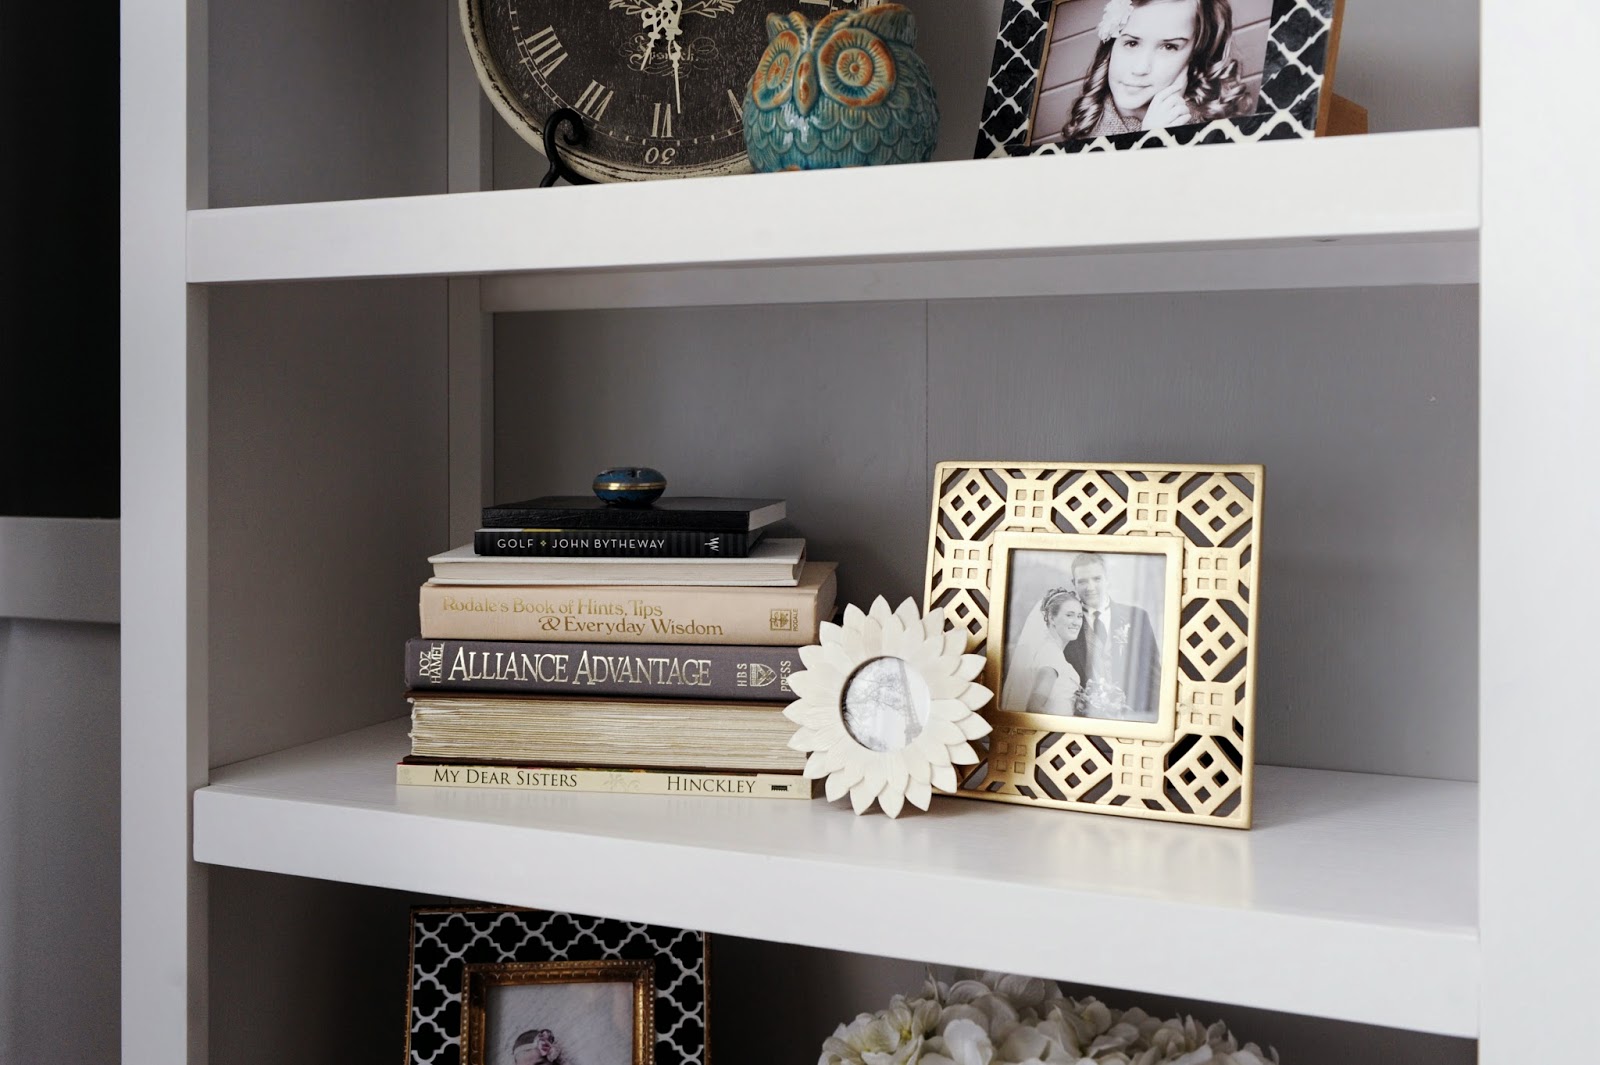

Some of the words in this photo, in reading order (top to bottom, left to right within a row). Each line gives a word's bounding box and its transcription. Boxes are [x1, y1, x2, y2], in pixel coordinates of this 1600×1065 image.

[644, 146, 676, 165] 30
[497, 538, 534, 549] GOLF
[552, 538, 589, 549] JOHN
[594, 538, 665, 549] BYTHEWAY
[442, 596, 509, 614] Rodale's
[512, 599, 555, 614] Book
[558, 599, 574, 614] of
[577, 599, 628, 617] Hints,
[631, 599, 663, 619] Tips
[538, 615, 561, 631] &
[564, 616, 645, 636] Everyday
[651, 618, 724, 636] Wisdom
[418, 651, 431, 677] DOZ
[430, 642, 445, 684] HAMEL
[448, 646, 569, 683] ALLIANCE
[572, 650, 712, 686] ADVANTAGE
[736, 663, 748, 687] HBS
[433, 768, 460, 783] MY
[466, 769, 511, 785] DEAR
[516, 771, 578, 787] SISTERS
[667, 776, 756, 793] HINCKLEY
